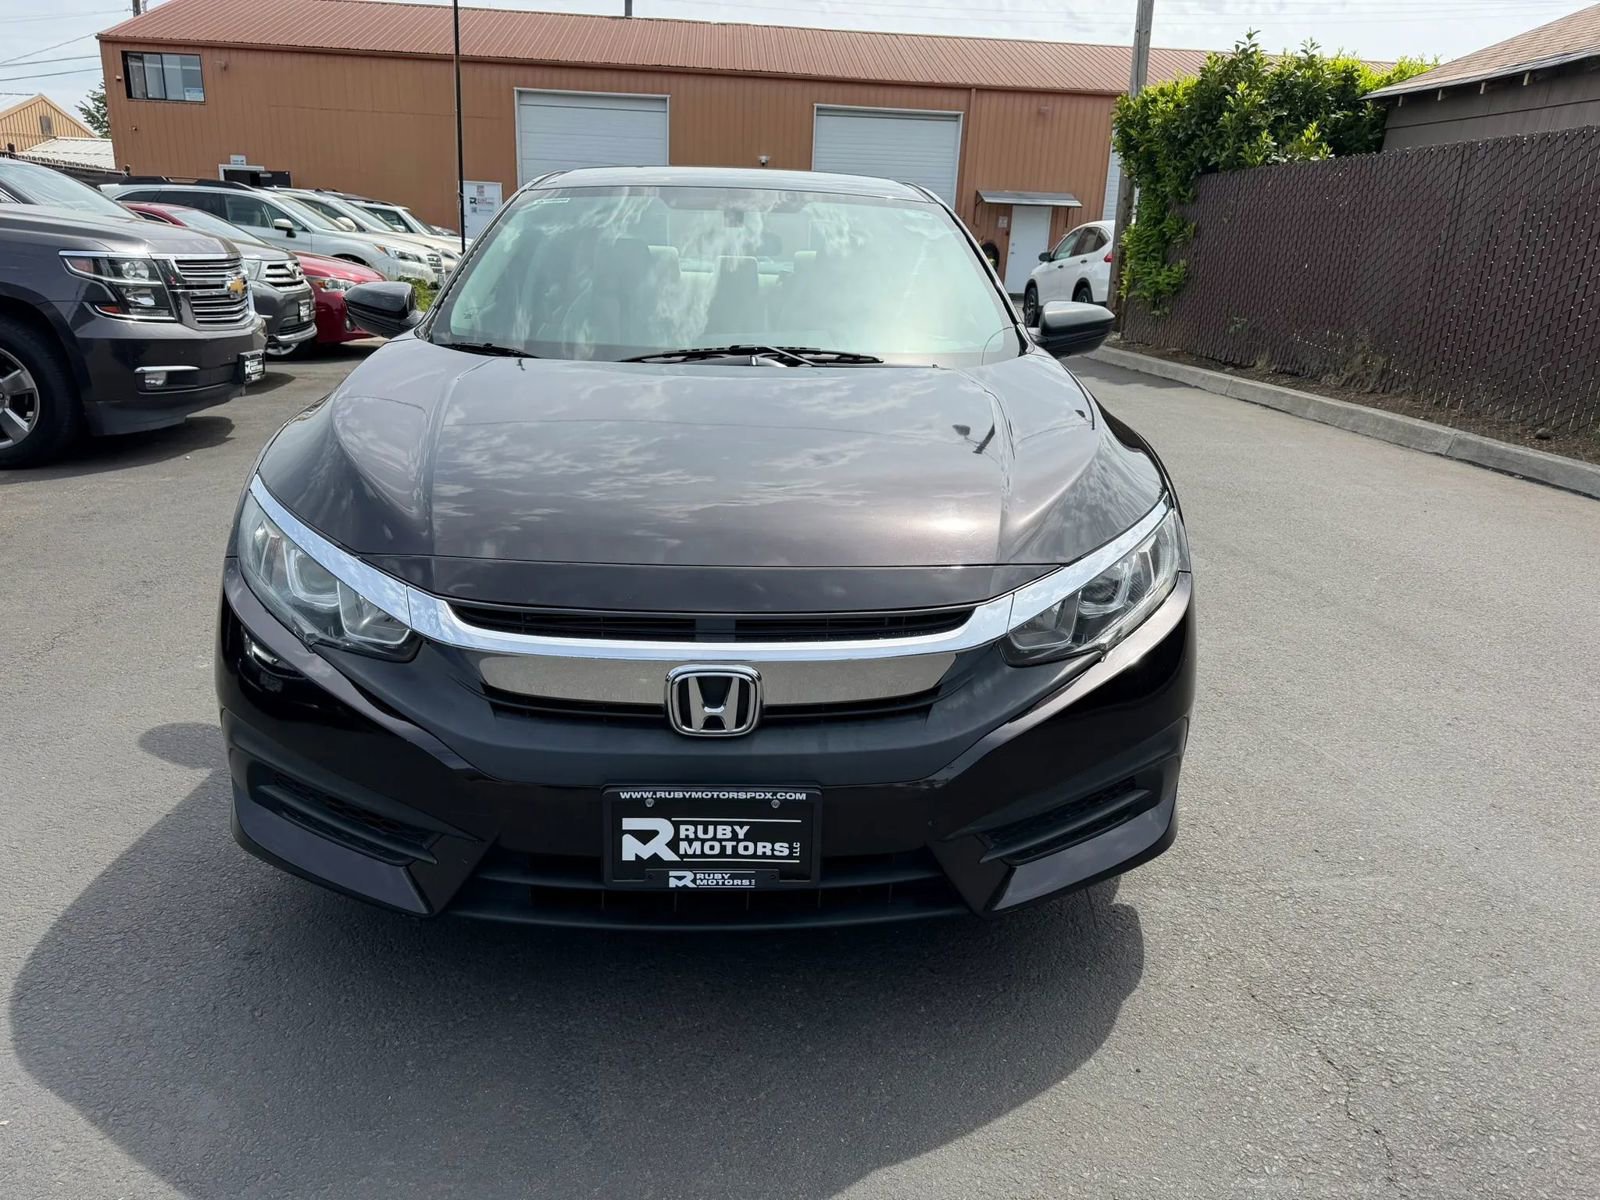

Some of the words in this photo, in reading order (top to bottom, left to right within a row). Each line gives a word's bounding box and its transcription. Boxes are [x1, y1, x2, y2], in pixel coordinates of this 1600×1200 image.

[619, 791, 806, 800] WWW.RUBYMOTORSPDX.COM
[679, 825, 750, 839] RUBY
[679, 841, 790, 856] MOTORS
[793, 842, 801, 857] LLC
